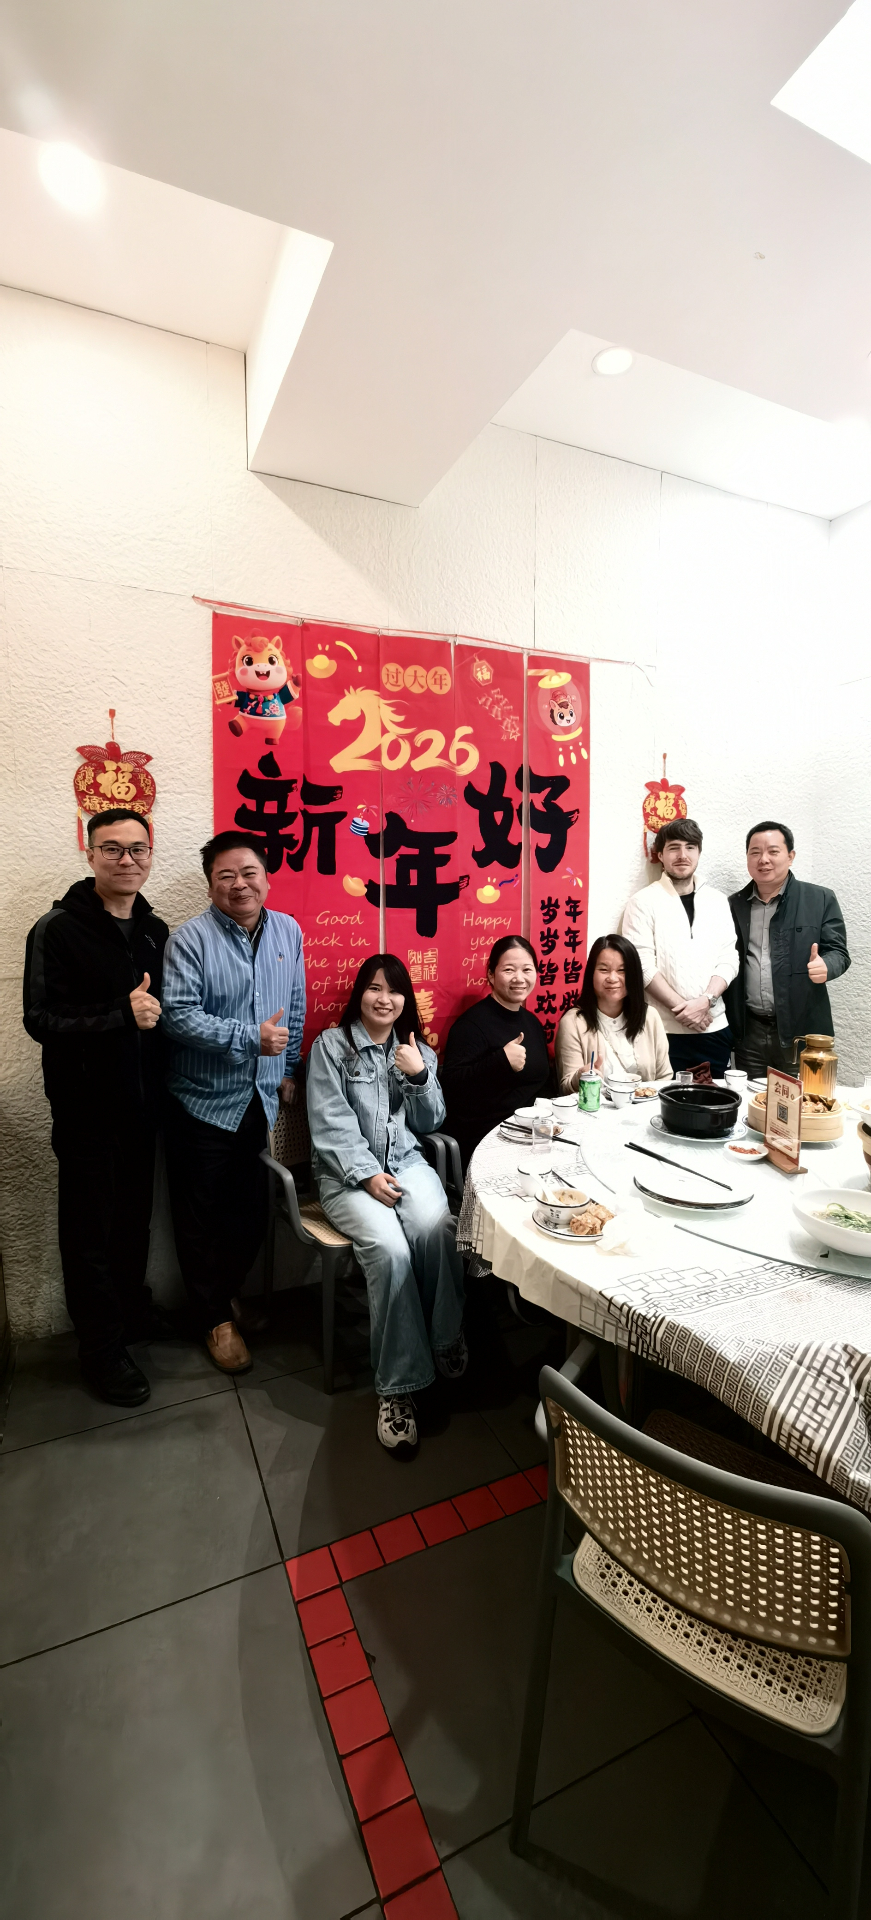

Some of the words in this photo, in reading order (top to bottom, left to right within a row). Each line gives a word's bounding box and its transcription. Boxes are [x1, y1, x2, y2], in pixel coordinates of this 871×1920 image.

[384, 667, 448, 691] 过大年
[475, 665, 491, 682] 福
[327, 686, 480, 777] 2026
[96, 760, 137, 802] 福
[655, 791, 677, 820] 福
[316, 910, 365, 926] Good
[463, 911, 512, 930] Happy
[350, 932, 371, 947] in
[337, 957, 365, 973] yea
[462, 952, 478, 971] of
[311, 976, 331, 994] of
[335, 976, 354, 990] th
[313, 998, 348, 1013] hor
